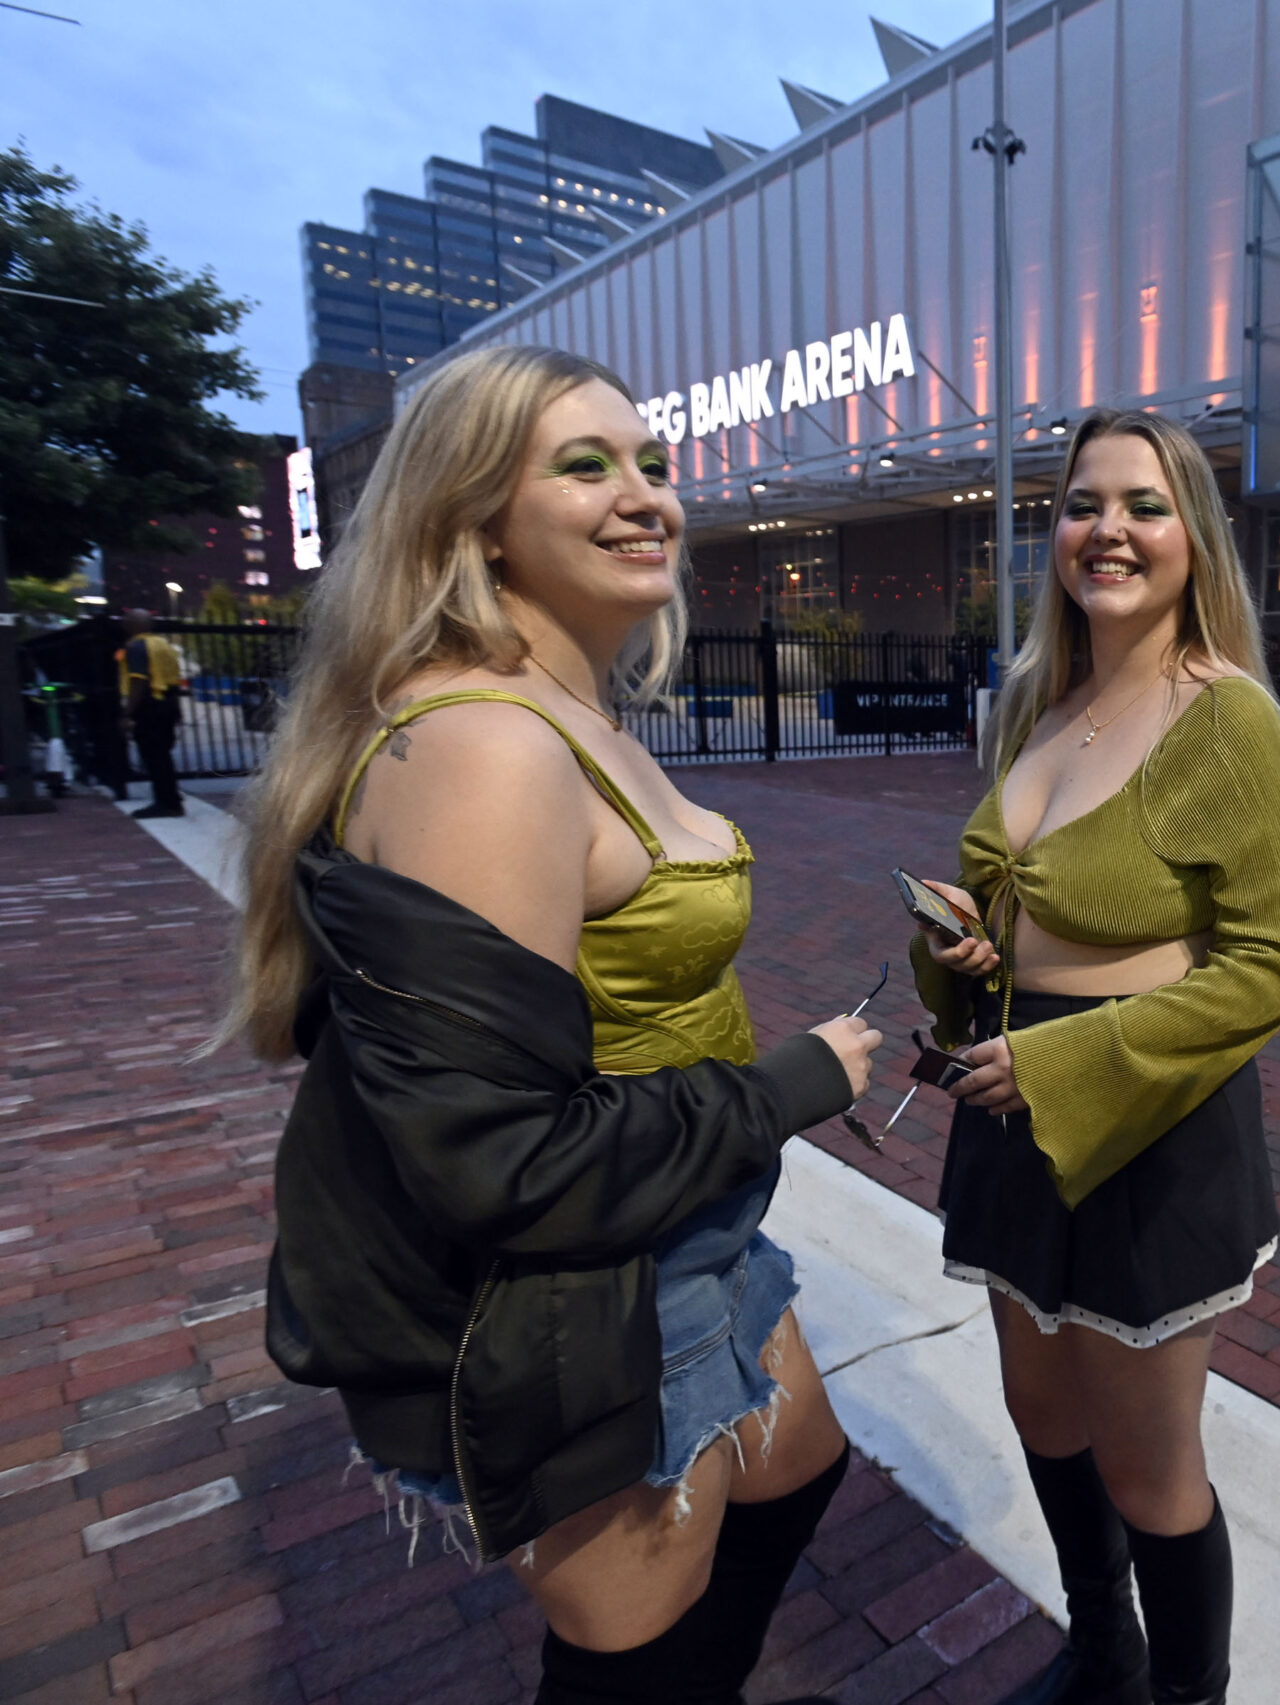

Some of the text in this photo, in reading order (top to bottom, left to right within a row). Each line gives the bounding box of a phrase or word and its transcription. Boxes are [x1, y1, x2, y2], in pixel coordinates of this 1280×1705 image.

[636, 313, 915, 444] FG BANK ARENA
[856, 694, 879, 707] VIP
